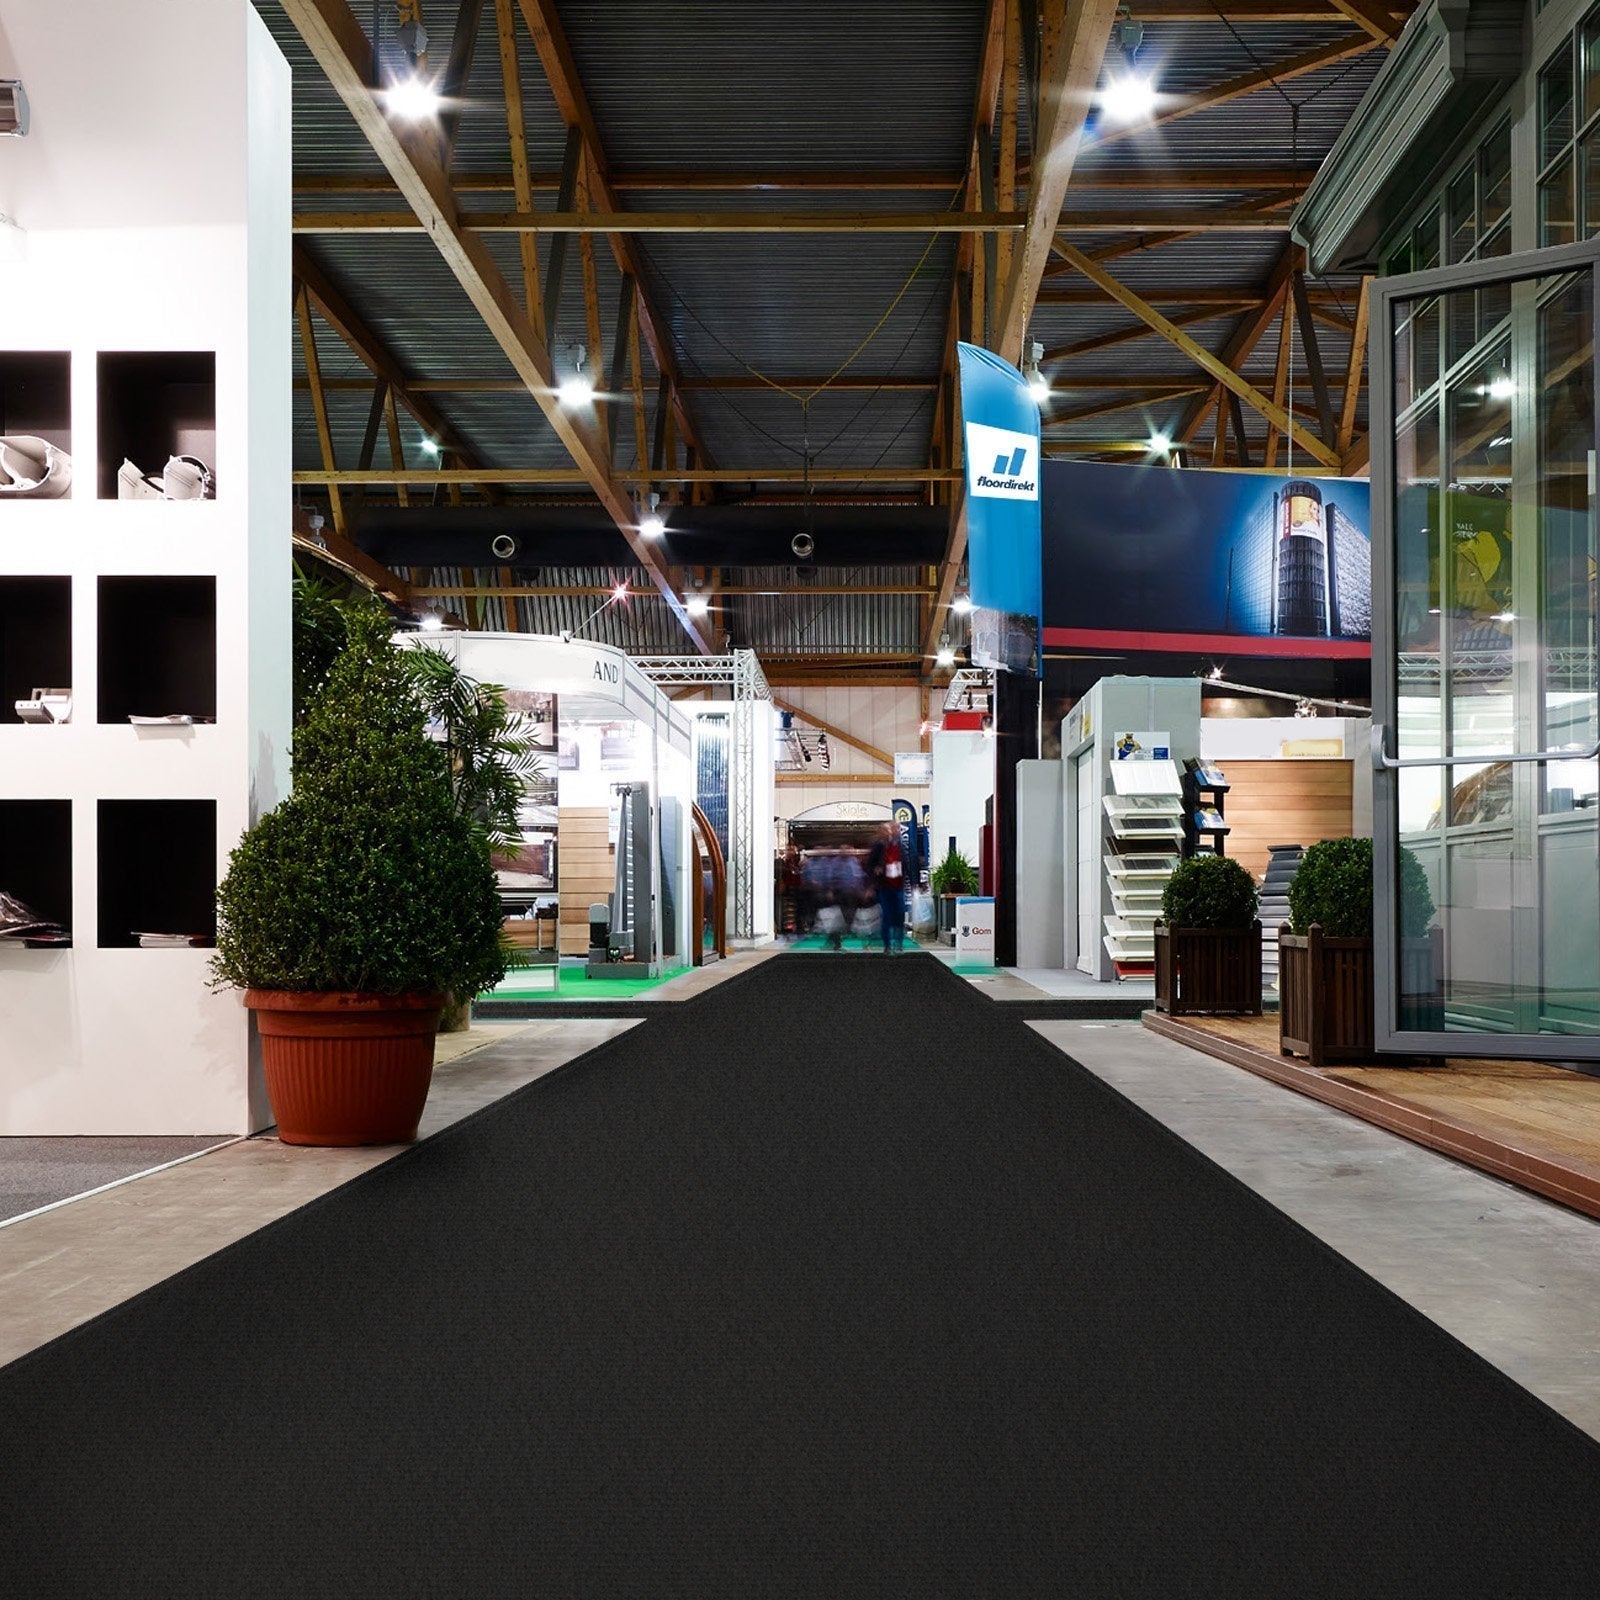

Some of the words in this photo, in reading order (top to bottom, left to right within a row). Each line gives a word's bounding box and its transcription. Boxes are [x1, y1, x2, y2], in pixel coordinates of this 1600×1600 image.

[977, 476, 1035, 491] floordirekt
[593, 660, 619, 684] AND
[972, 927, 992, 935] Gom
